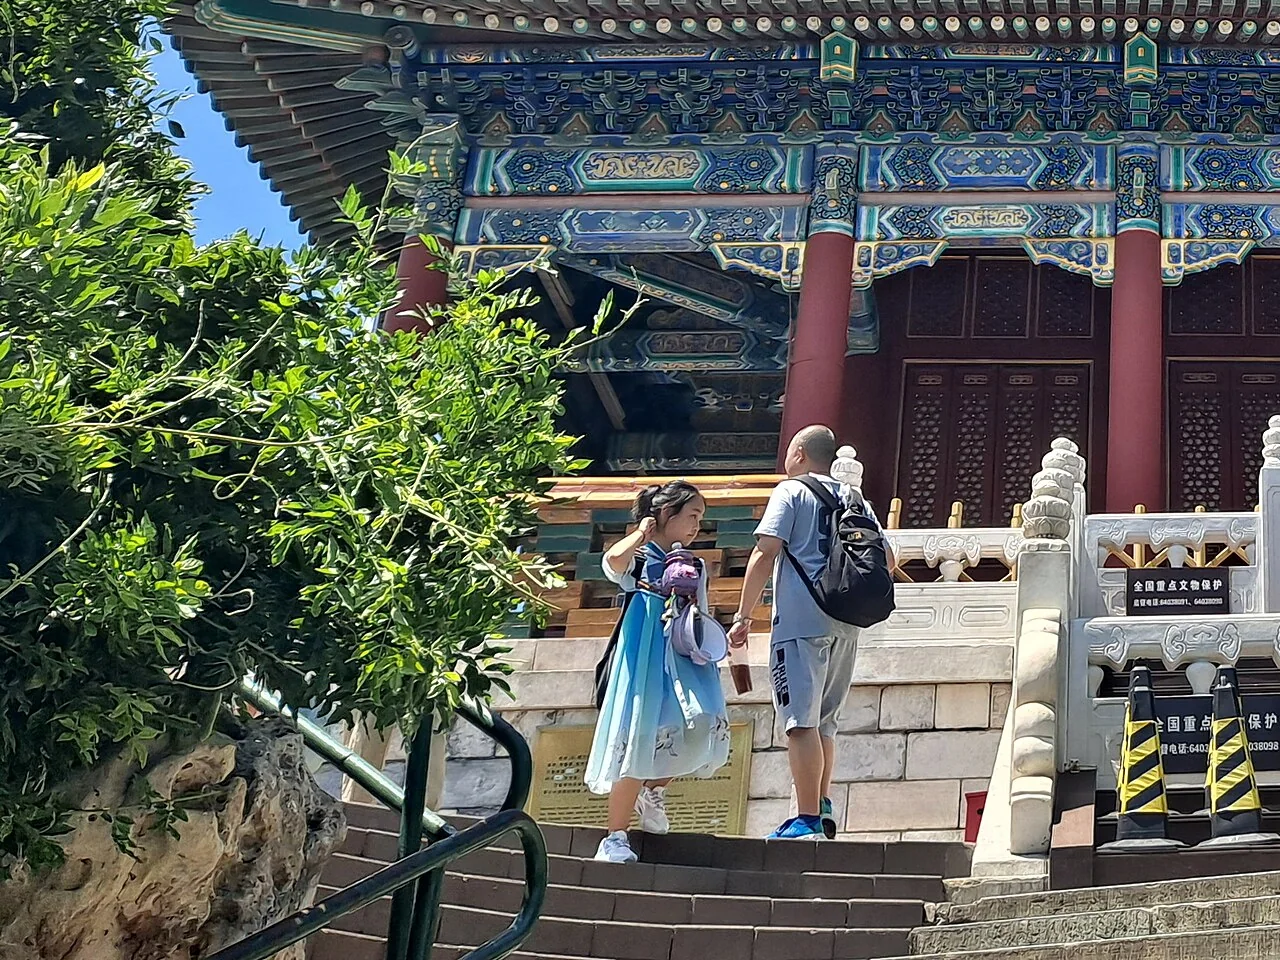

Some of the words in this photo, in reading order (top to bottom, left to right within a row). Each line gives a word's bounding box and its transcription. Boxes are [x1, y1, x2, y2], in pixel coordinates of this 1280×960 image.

[1133, 579, 1222, 592] 全国重点文物保护
